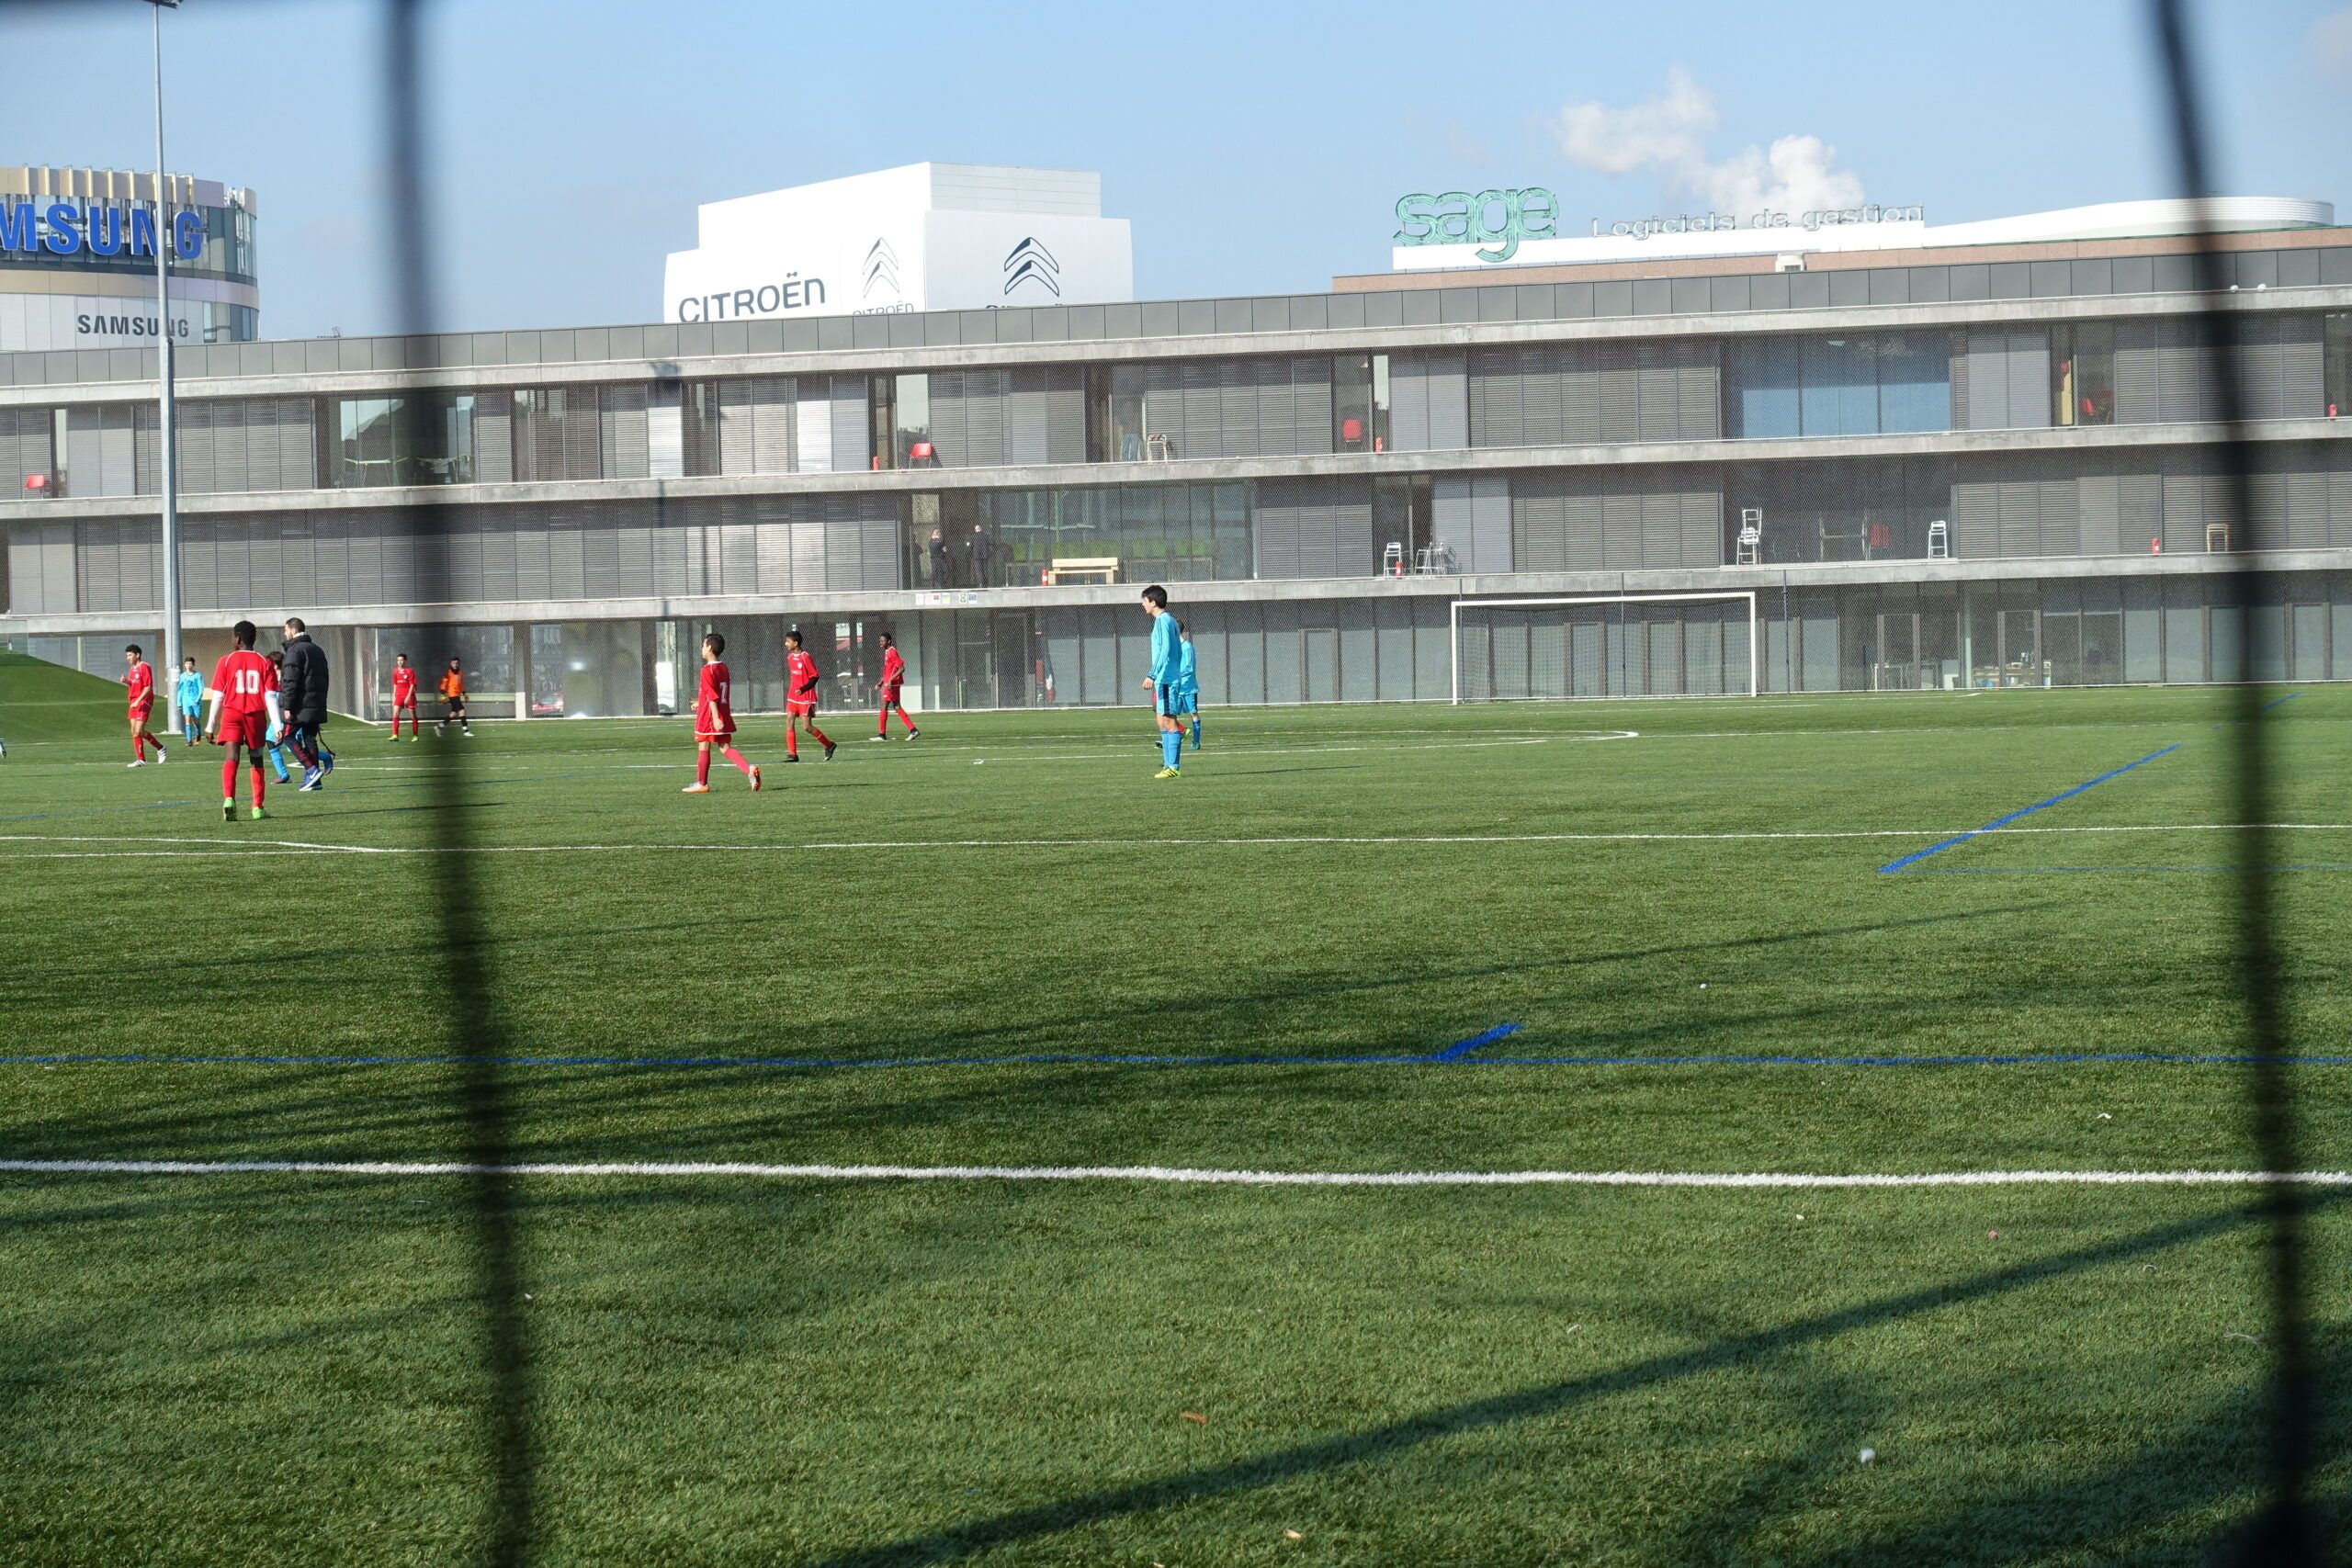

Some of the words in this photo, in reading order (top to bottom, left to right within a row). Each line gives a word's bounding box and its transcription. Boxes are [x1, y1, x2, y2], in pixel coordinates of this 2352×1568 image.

[1393, 187, 1559, 263] sage
[1591, 211, 1736, 241] Logiciels
[1751, 209, 1789, 229] de
[1802, 204, 1924, 231] gestion
[235, 669, 260, 694] 10
